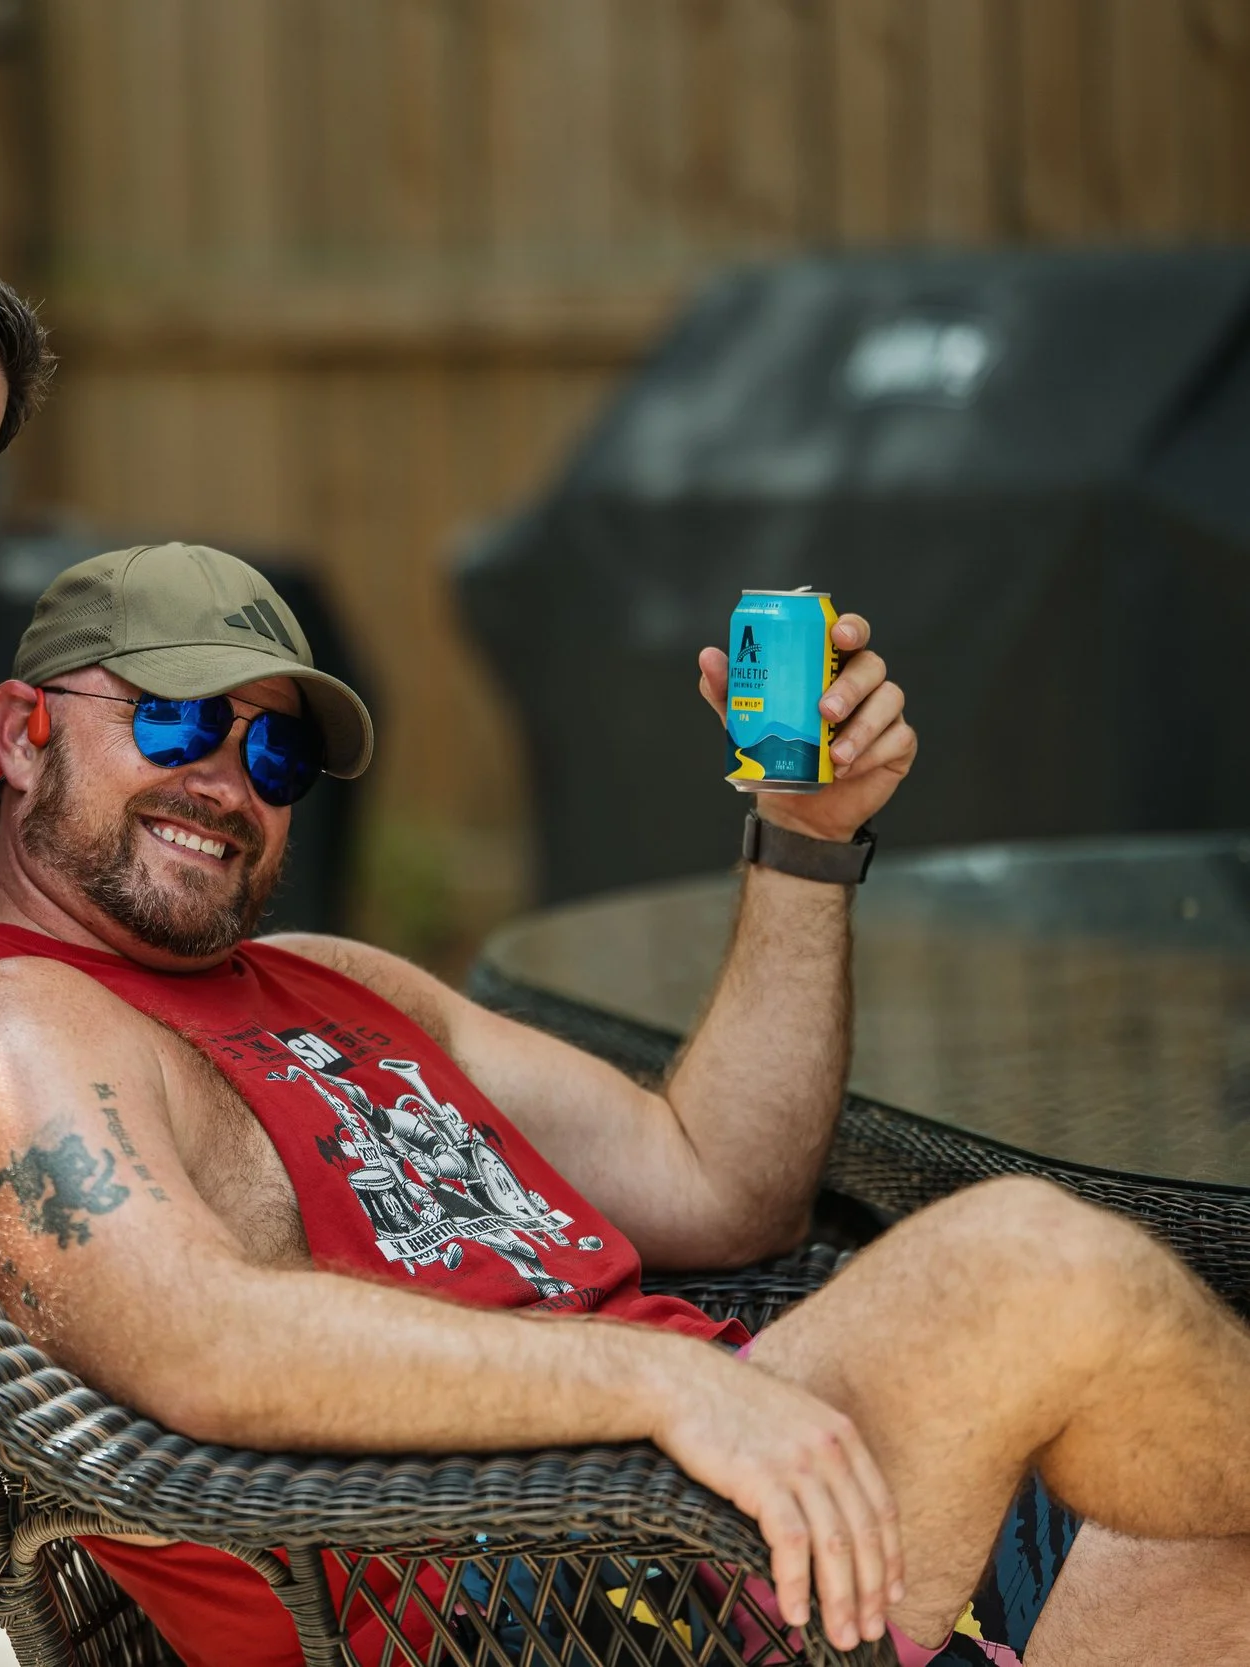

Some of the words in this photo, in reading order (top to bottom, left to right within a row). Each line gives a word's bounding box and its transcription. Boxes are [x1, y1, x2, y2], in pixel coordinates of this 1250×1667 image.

[731, 667, 769, 680] ATHLETIC
[739, 713, 749, 722] IPA
[288, 1033, 342, 1069] SH
